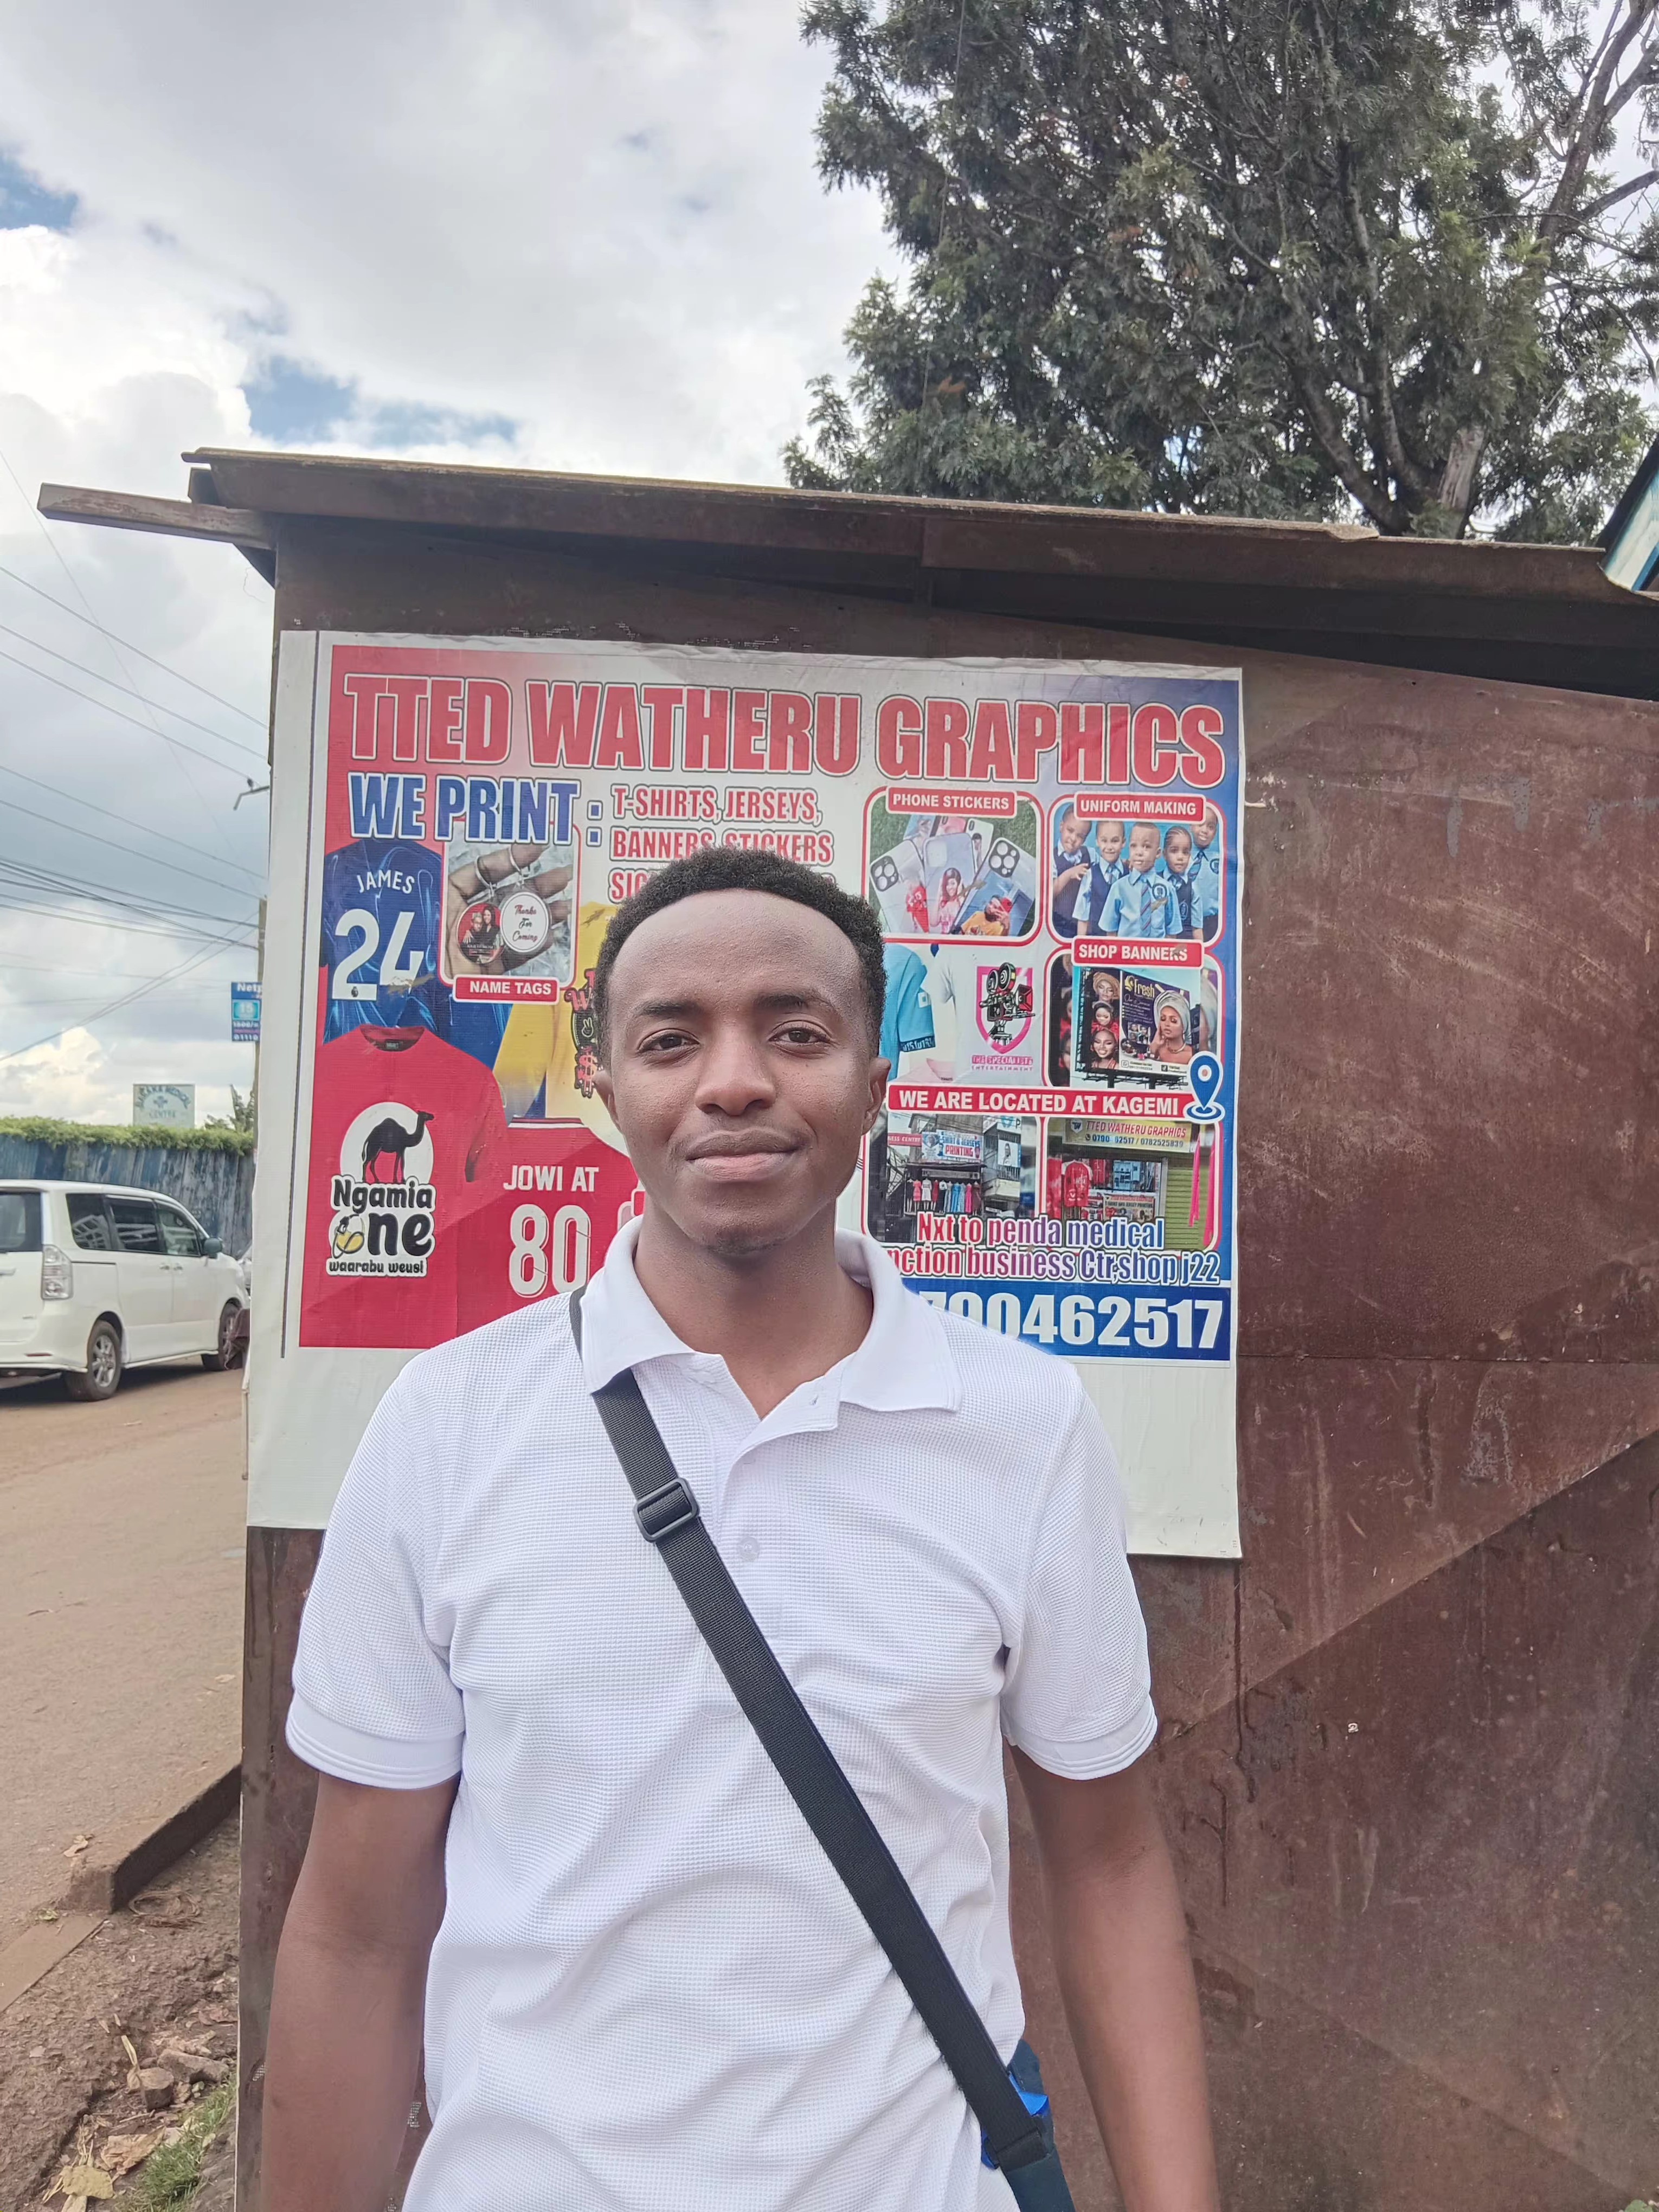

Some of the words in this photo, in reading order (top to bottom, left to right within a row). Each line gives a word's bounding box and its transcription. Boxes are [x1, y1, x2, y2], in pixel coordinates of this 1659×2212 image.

[345, 674, 512, 764] TTED
[526, 680, 861, 776] WATHERU
[876, 695, 1225, 787] GRAPHICS
[349, 774, 425, 839] WE
[614, 787, 722, 822] T-SHIRTS,
[726, 790, 822, 826] JERSEYS,
[893, 793, 938, 808] PHONE
[943, 795, 1009, 811] STICKERS
[1081, 798, 1140, 814] UNIFORM
[1143, 800, 1196, 815] MAKING
[357, 869, 415, 893] JAMES
[512, 930, 538, 943] Coming
[332, 908, 424, 1000] 24
[1078, 944, 1118, 959] SHOP
[1121, 946, 1188, 962] BANNERS
[470, 980, 511, 993] NAME
[515, 982, 552, 995] TAGS
[899, 1090, 930, 1107] WE
[934, 1091, 973, 1109] ARE
[979, 1094, 1066, 1113] LOCATED
[1072, 1095, 1097, 1113] AT
[1102, 1096, 1179, 1115] KAGEMI
[1086, 1121, 1106, 1131] TTED
[1108, 1122, 1146, 1135] WATHERU
[1147, 1126, 1187, 1138] GRAPHICS
[503, 1165, 564, 1192] JOWI
[571, 1166, 600, 1193] AT
[333, 1179, 433, 1214] Ngamia
[920, 1216, 955, 1242] Nxt
[960, 1219, 983, 1244] to
[988, 1220, 1060, 1248] penda
[1068, 1220, 1163, 1249] medical
[510, 1203, 592, 1298] 80
[329, 1259, 384, 1273] waarabu
[966, 1246, 1073, 1278] business
[1180, 1253, 1219, 1284] j22
